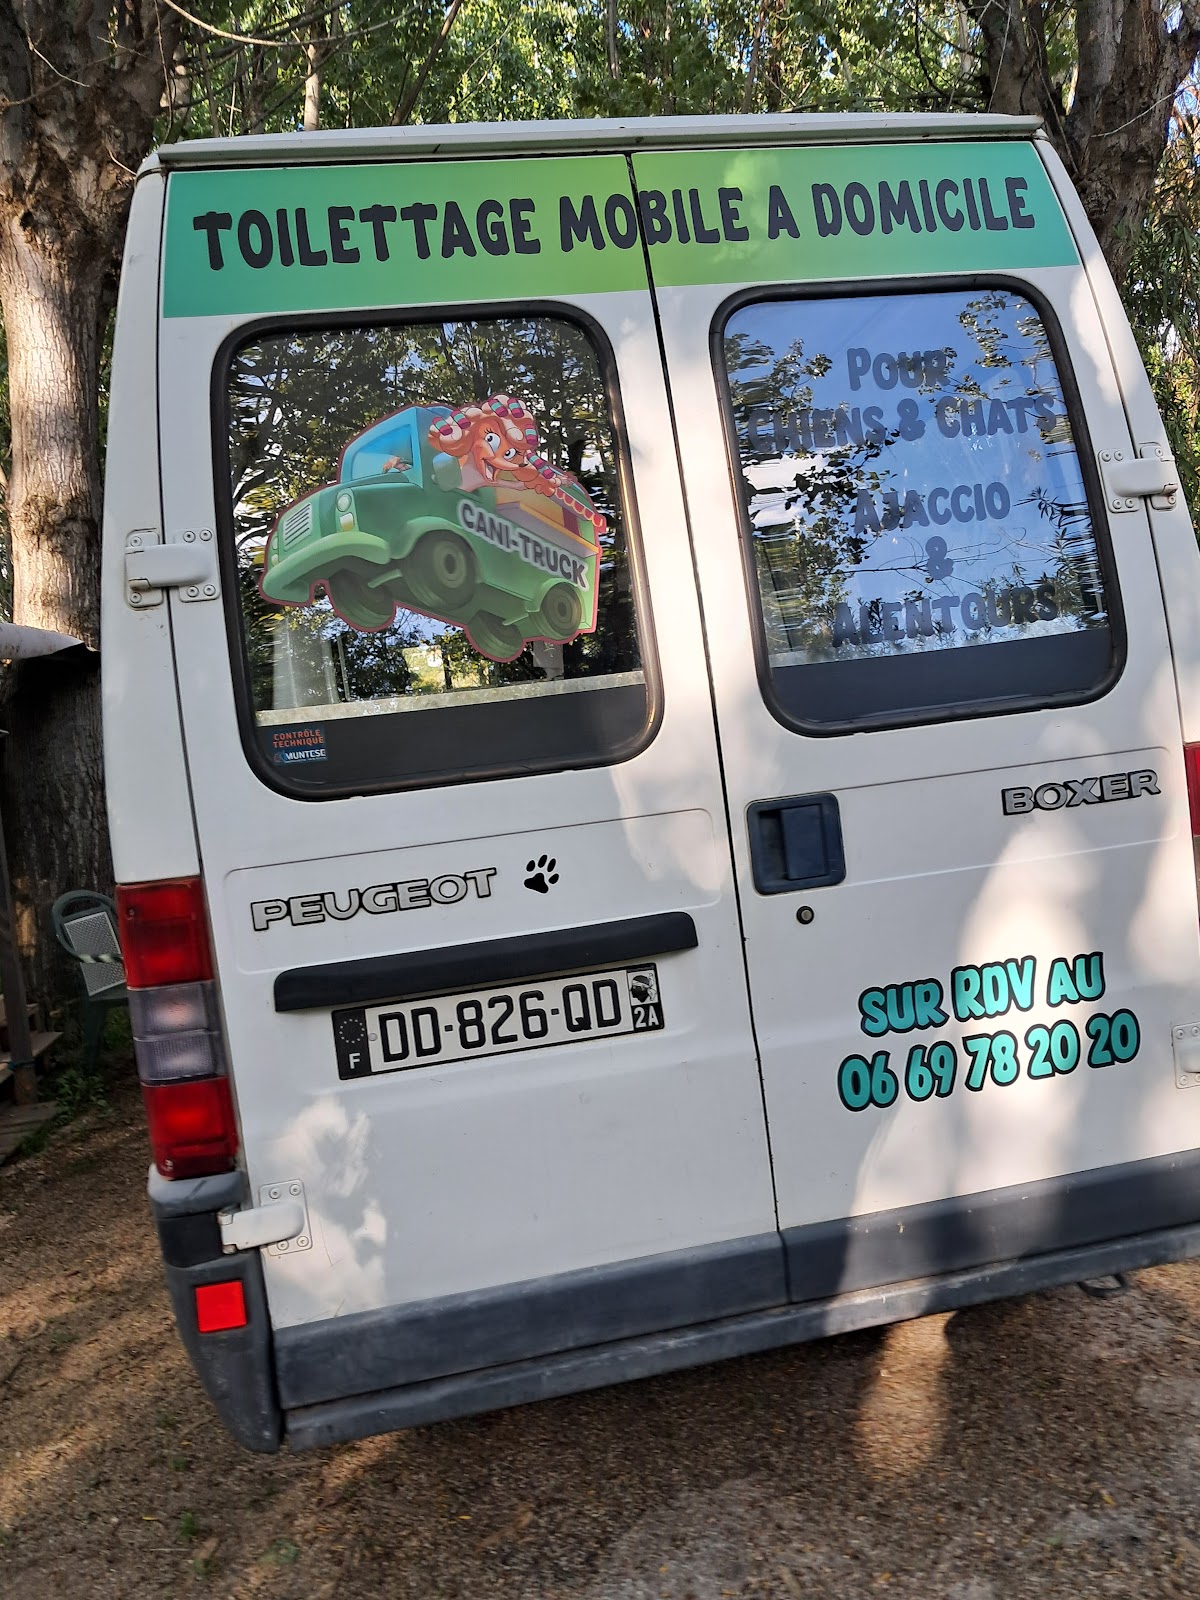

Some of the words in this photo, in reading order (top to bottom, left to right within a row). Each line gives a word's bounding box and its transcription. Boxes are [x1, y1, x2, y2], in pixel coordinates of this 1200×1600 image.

[193, 198, 541, 271] TOILETTAGE
[559, 187, 749, 252] MOBILE
[768, 185, 800, 240] A
[811, 177, 1034, 238] DOMICILE
[749, 406, 886, 451] CHIENS
[897, 399, 926, 441] &
[936, 395, 1056, 438] CHATS
[854, 482, 1011, 534] AJACCIO
[460, 501, 587, 589] CANI-TRUCK
[925, 536, 954, 580] &
[832, 584, 1057, 647] ALENTOURS
[273, 729, 320, 741] CONTRÔLE
[273, 737, 324, 748] TECHNIQUE
[1001, 769, 1161, 815] BOXER
[251, 867, 497, 931] PEUGEOT
[378, 978, 622, 1063] DD-826-QD
[633, 1004, 659, 1029] 2A
[858, 978, 950, 1037] SUR
[951, 955, 1036, 1022] RDV
[1047, 951, 1106, 1007] AU
[349, 1052, 361, 1070] F
[837, 1050, 899, 1112] 06
[905, 1041, 958, 1102] 69
[961, 1030, 1018, 1091] 78
[1024, 1019, 1080, 1080] 20
[1086, 1008, 1140, 1068] 20
